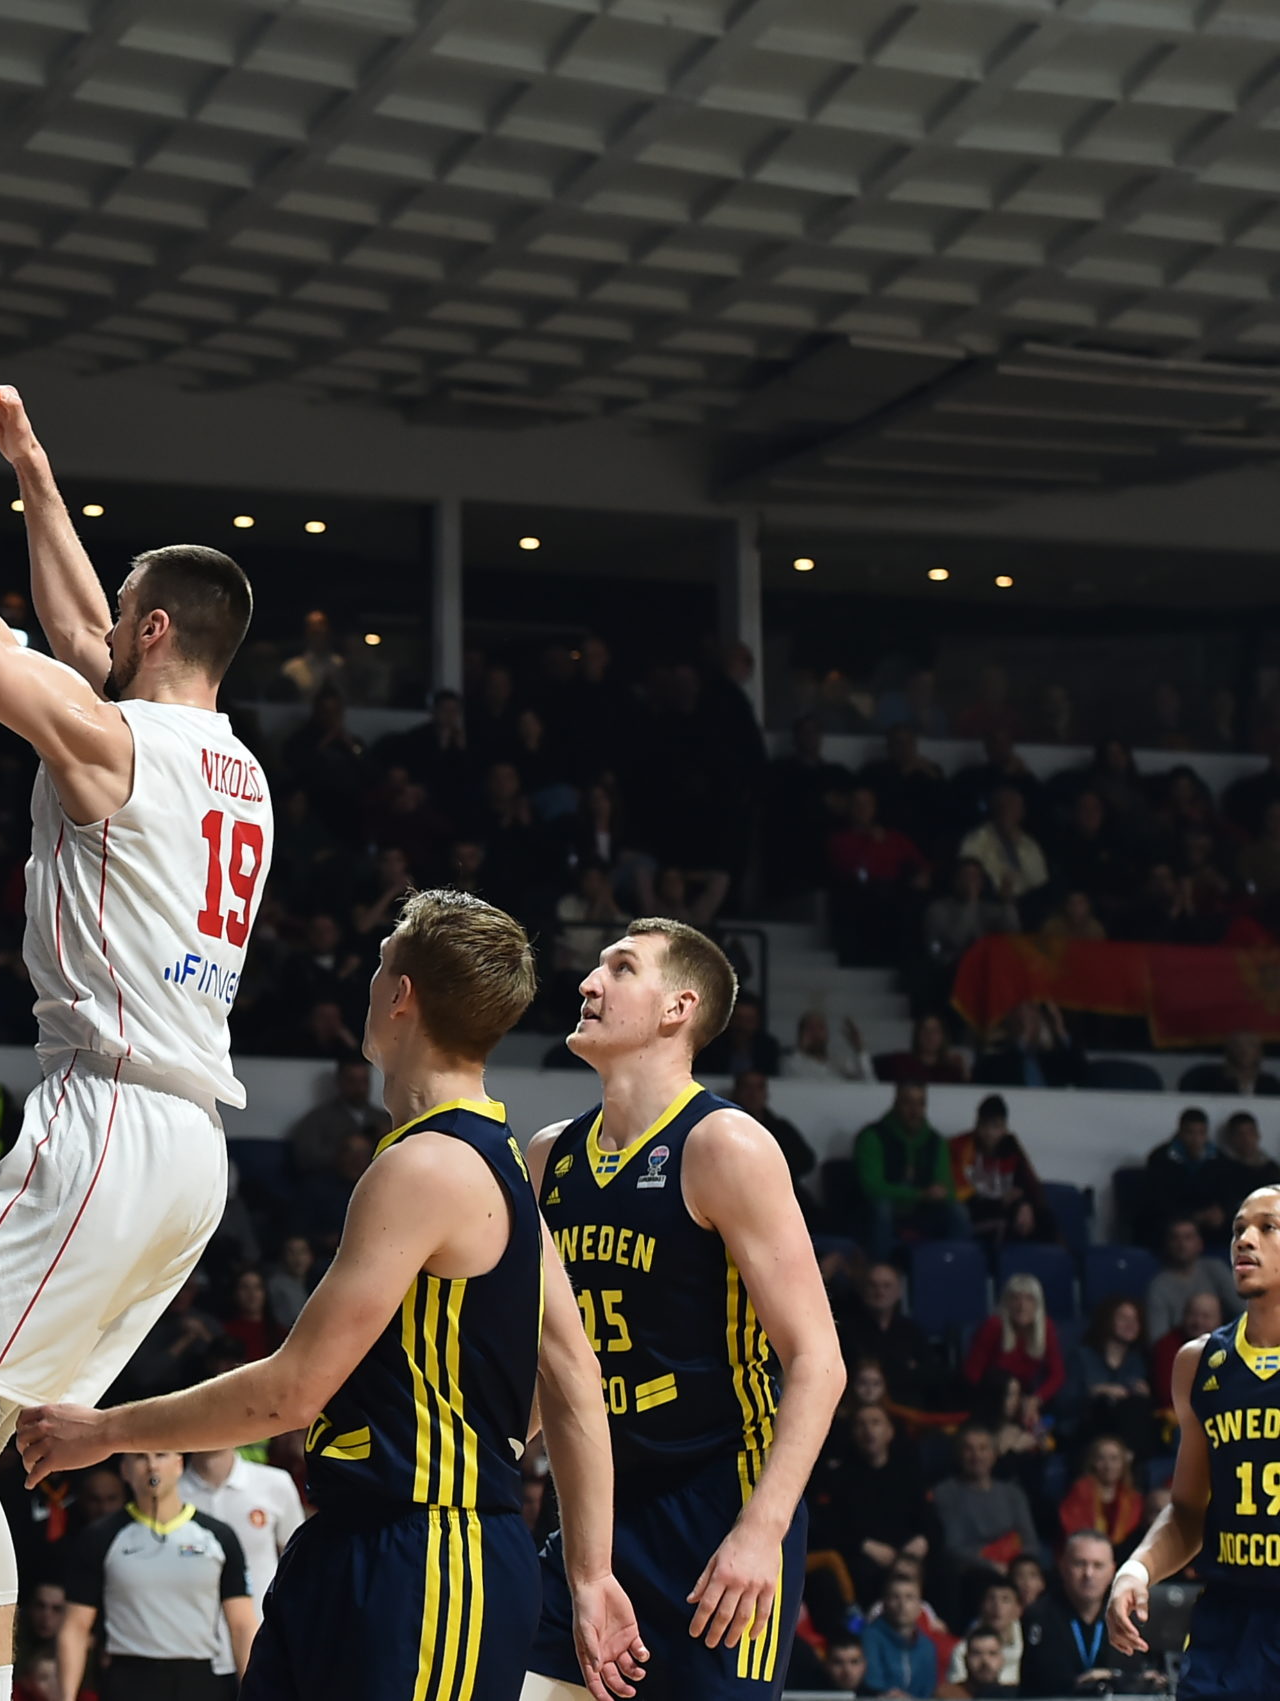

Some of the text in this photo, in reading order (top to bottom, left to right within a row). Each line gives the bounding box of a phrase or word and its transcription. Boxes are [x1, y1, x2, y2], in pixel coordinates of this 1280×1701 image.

[197, 809, 264, 949] 19
[578, 1289, 633, 1352] 15
[1235, 1461, 1280, 1516] 19
